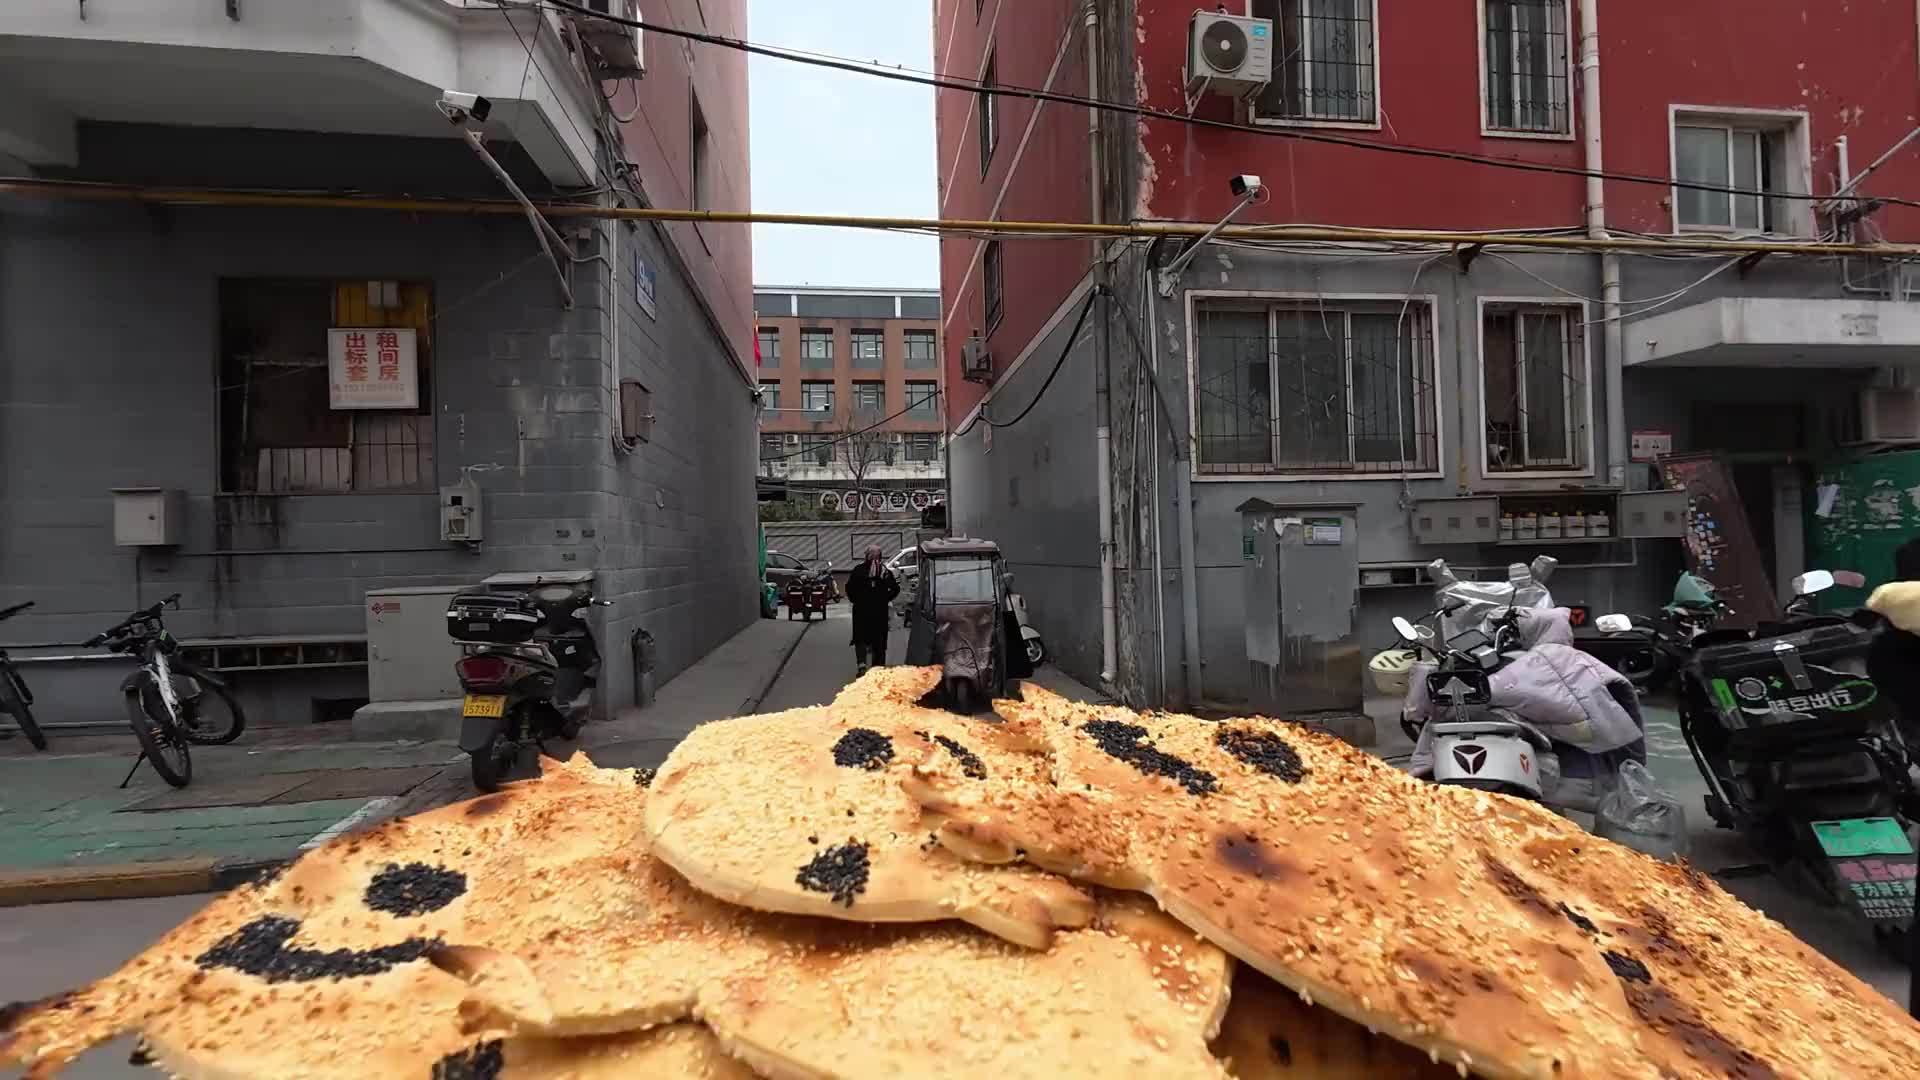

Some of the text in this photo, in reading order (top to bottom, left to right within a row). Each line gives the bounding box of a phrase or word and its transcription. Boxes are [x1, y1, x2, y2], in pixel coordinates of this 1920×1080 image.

[345, 331, 399, 348] 出租
[344, 348, 399, 365] 标间
[344, 365, 400, 382] 套房
